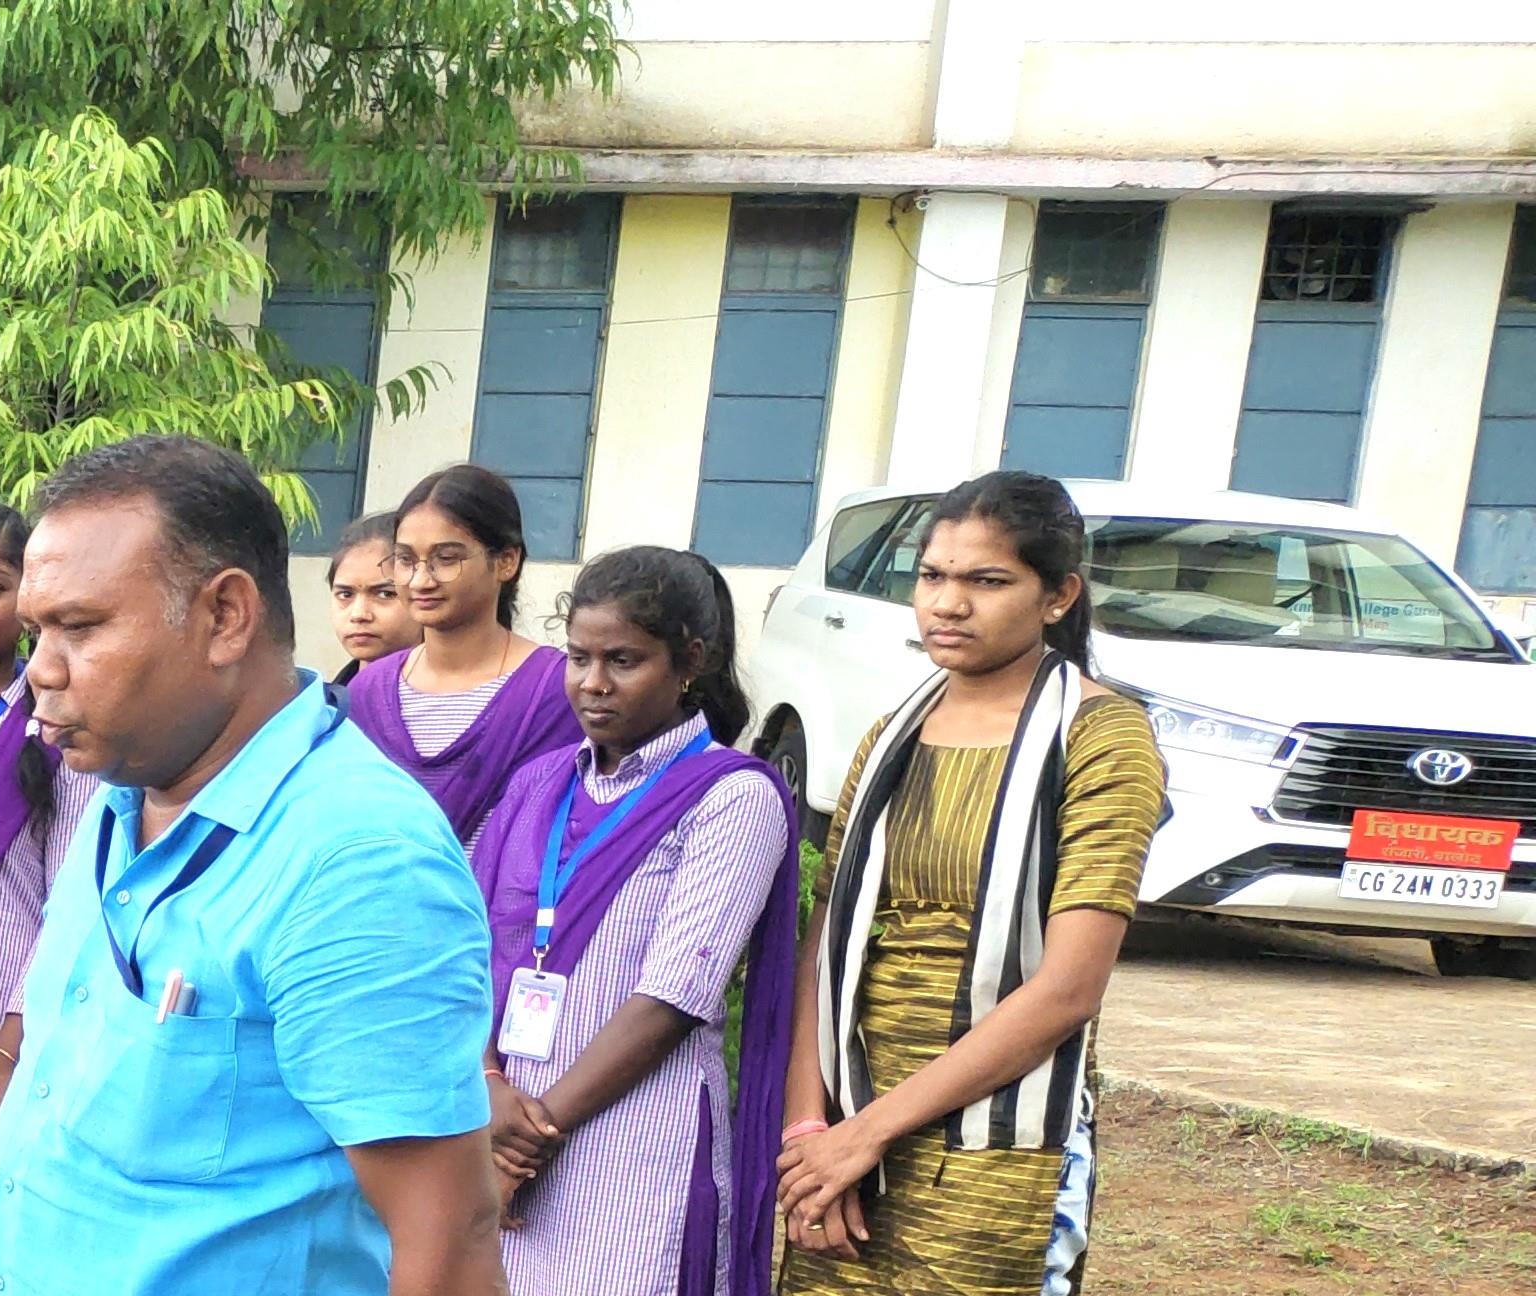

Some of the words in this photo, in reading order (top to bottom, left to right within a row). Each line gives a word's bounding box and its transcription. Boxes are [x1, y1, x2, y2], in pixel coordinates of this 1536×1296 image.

[1363, 813, 1505, 846] विधायक
[1359, 871, 1385, 893] CG
[1441, 876, 1497, 901] 0333
